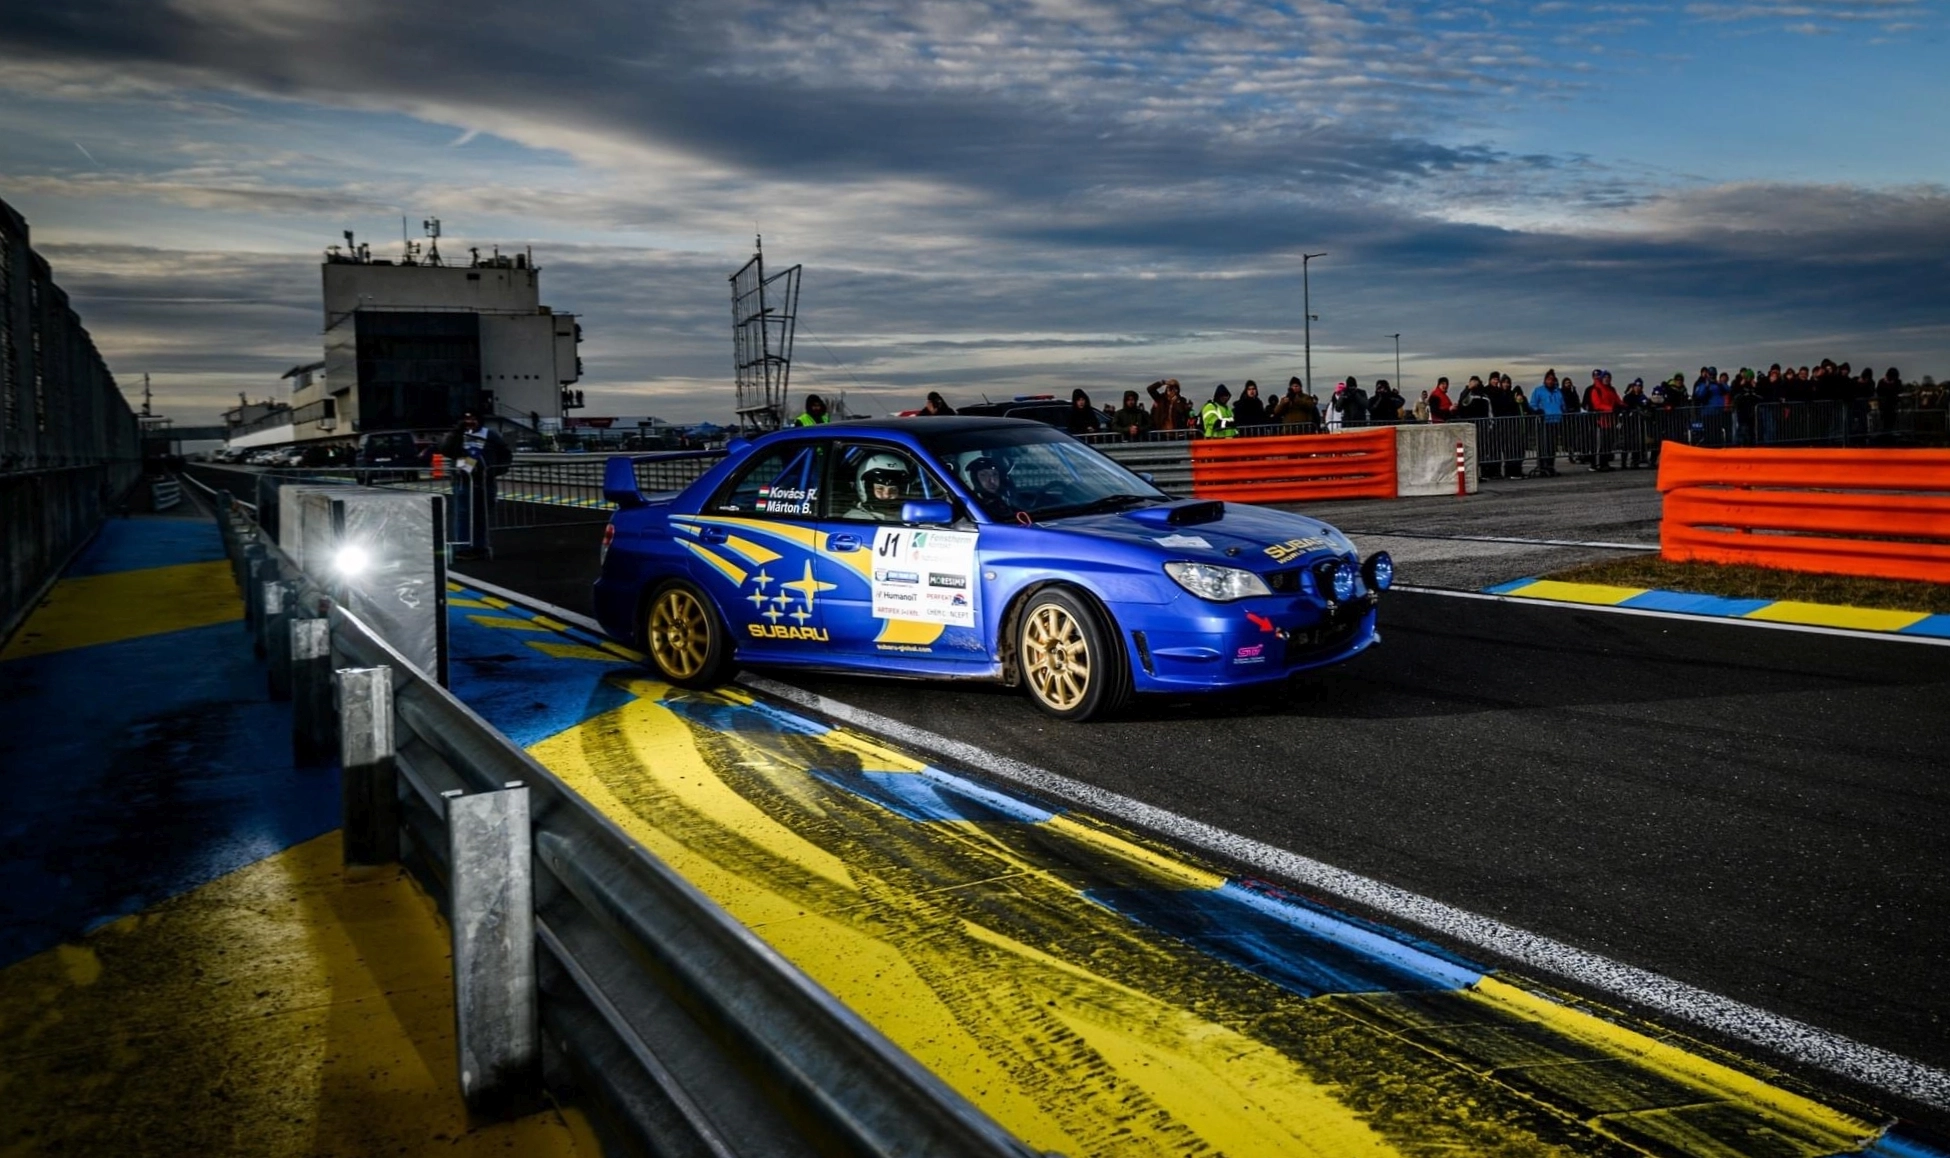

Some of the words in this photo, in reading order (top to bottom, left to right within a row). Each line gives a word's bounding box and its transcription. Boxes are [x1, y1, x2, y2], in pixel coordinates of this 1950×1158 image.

[769, 487, 805, 499] Kovács
[806, 488, 818, 500] R.
[766, 500, 800, 513] Márton
[801, 502, 812, 514] B.
[879, 533, 900, 557] J1
[748, 623, 829, 641] SUBARU
